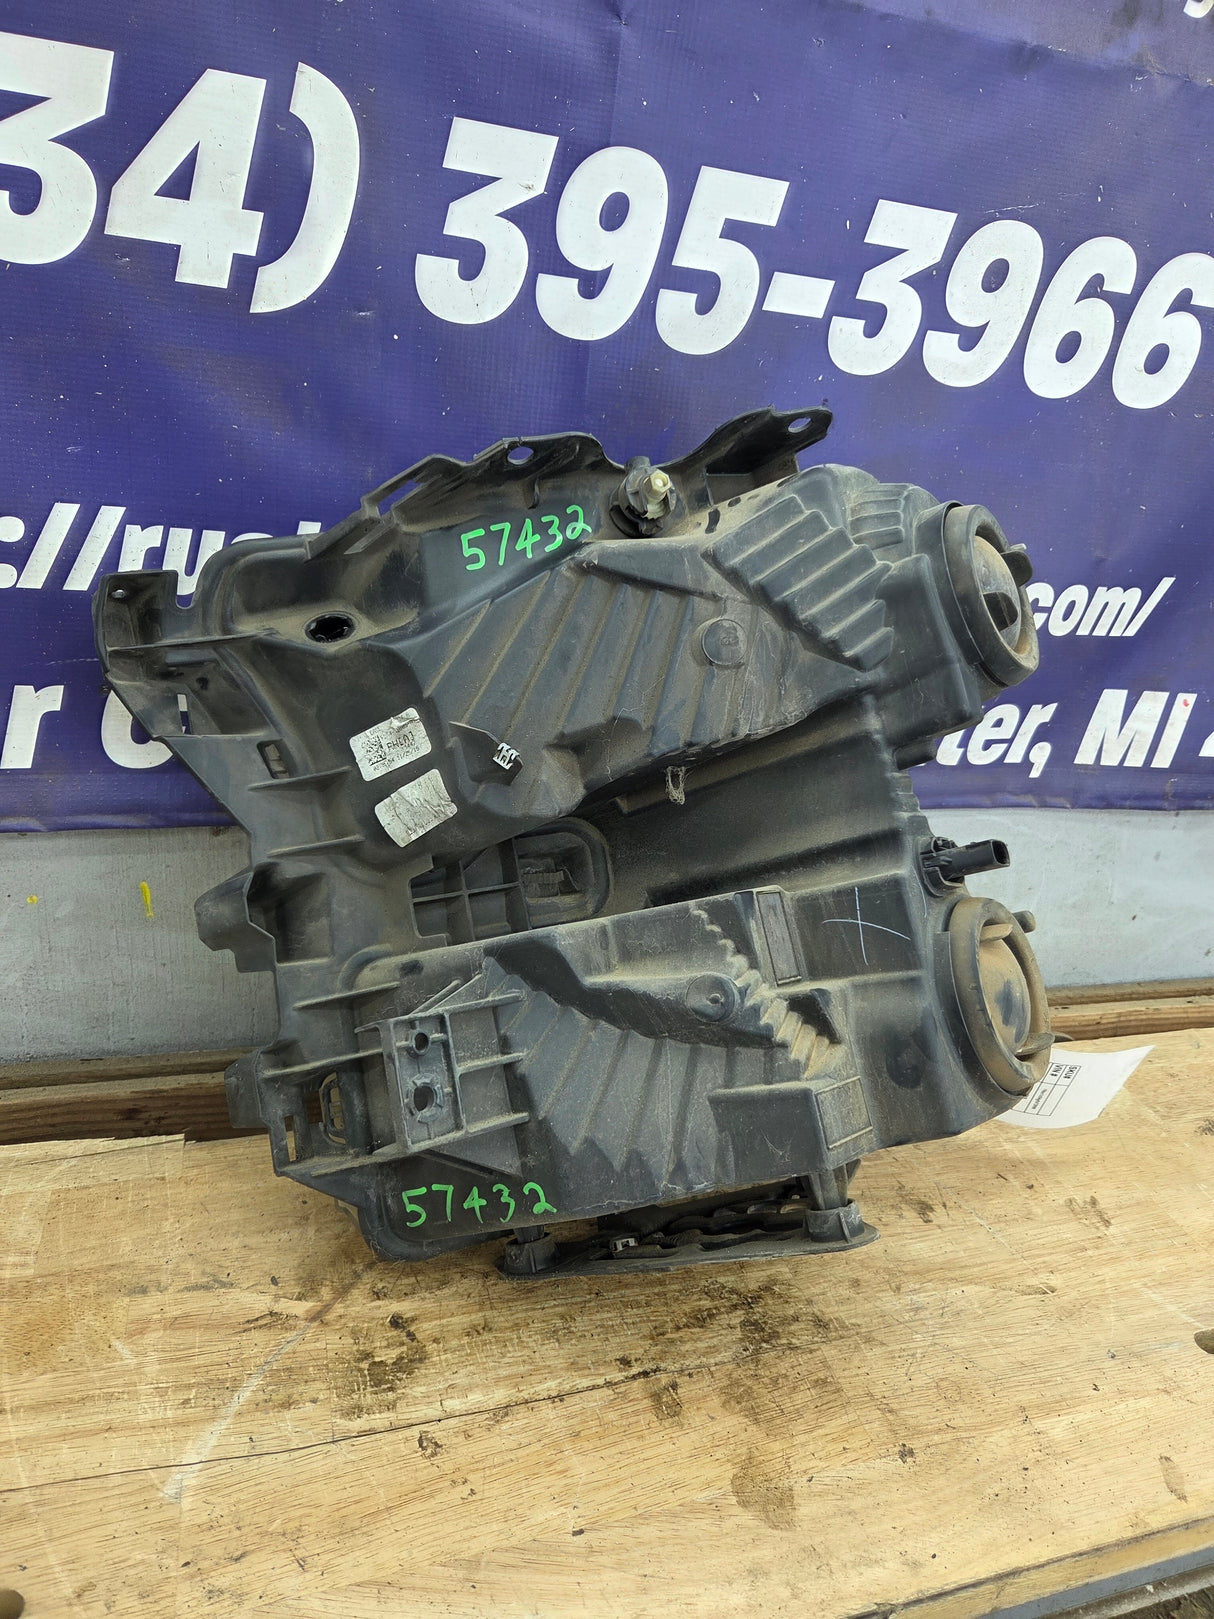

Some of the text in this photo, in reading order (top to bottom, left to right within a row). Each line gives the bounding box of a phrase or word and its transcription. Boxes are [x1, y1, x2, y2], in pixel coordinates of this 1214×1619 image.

[415, 116, 1214, 409] 395-3966
[460, 504, 593, 571] 57432
[1073, 688, 1198, 769] MI
[401, 1181, 558, 1228] 57432
